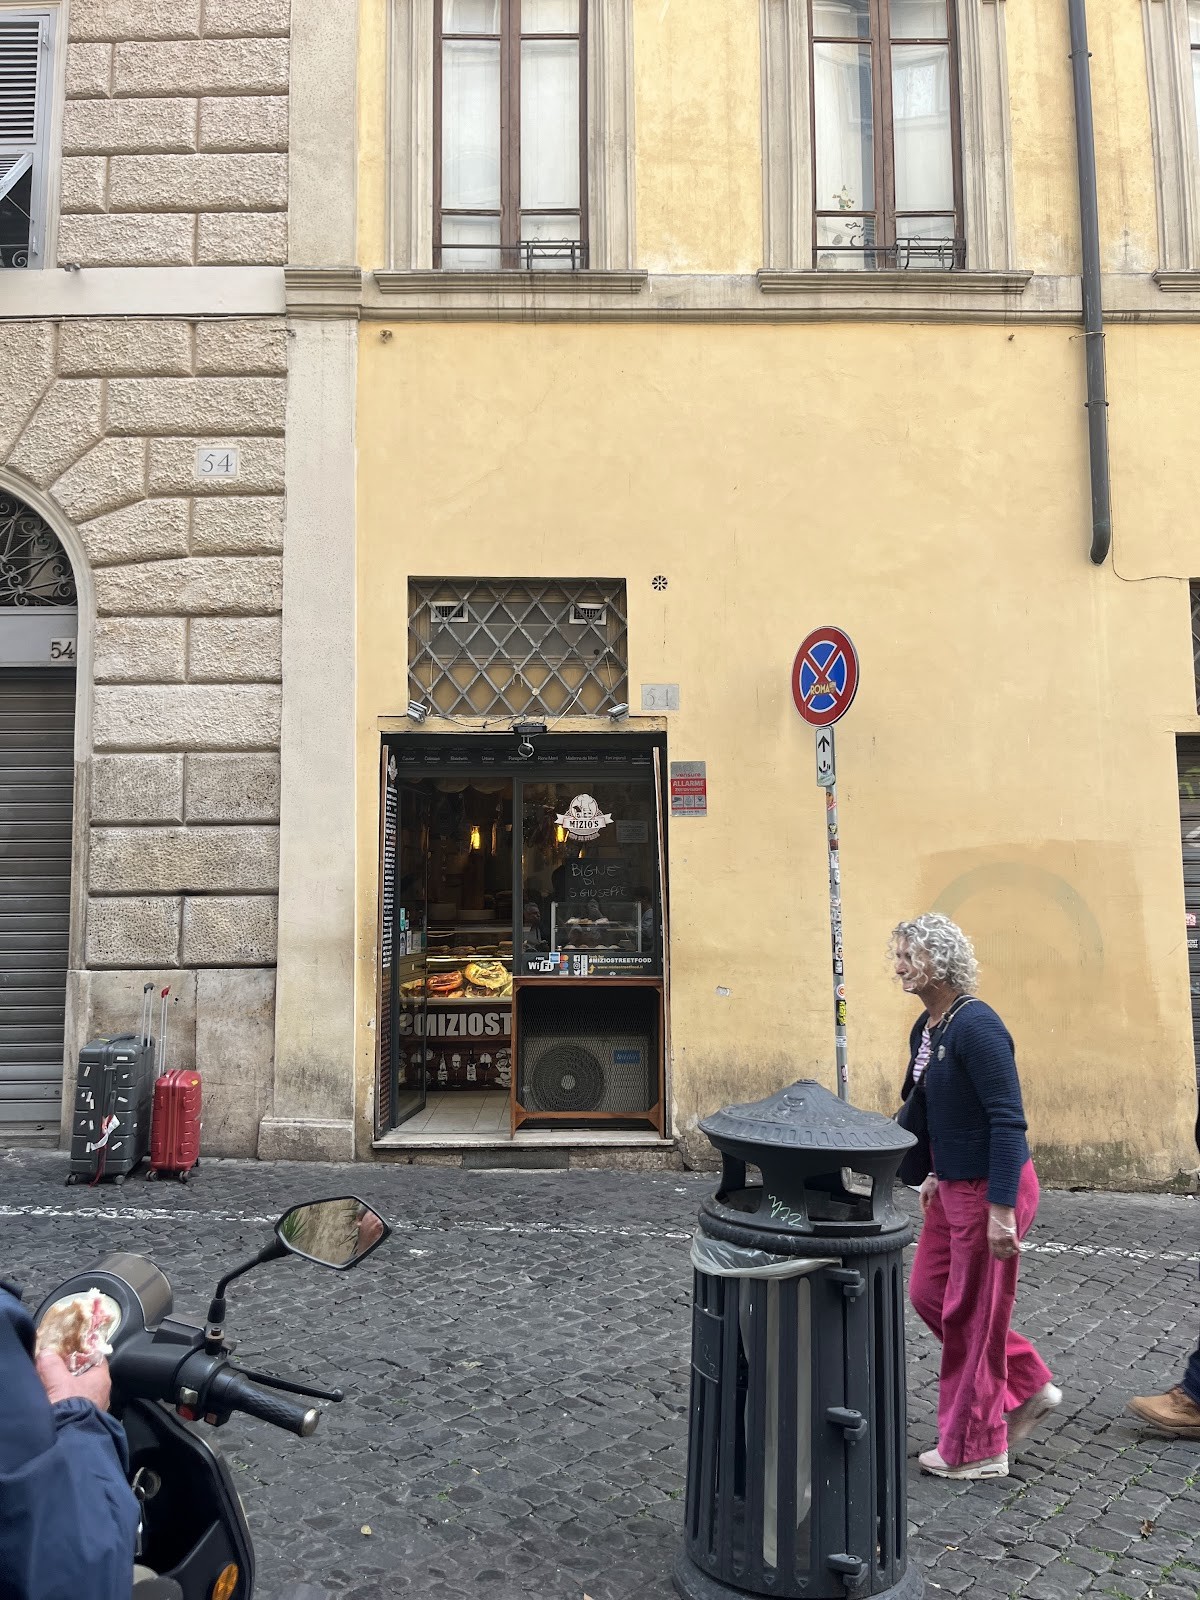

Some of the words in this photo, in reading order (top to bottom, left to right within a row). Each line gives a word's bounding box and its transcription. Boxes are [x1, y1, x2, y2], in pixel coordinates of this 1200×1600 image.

[201, 453, 234, 474] 54
[51, 641, 76, 660] 54
[810, 684, 831, 696] ROMA
[569, 820, 599, 829] MIZIO'S
